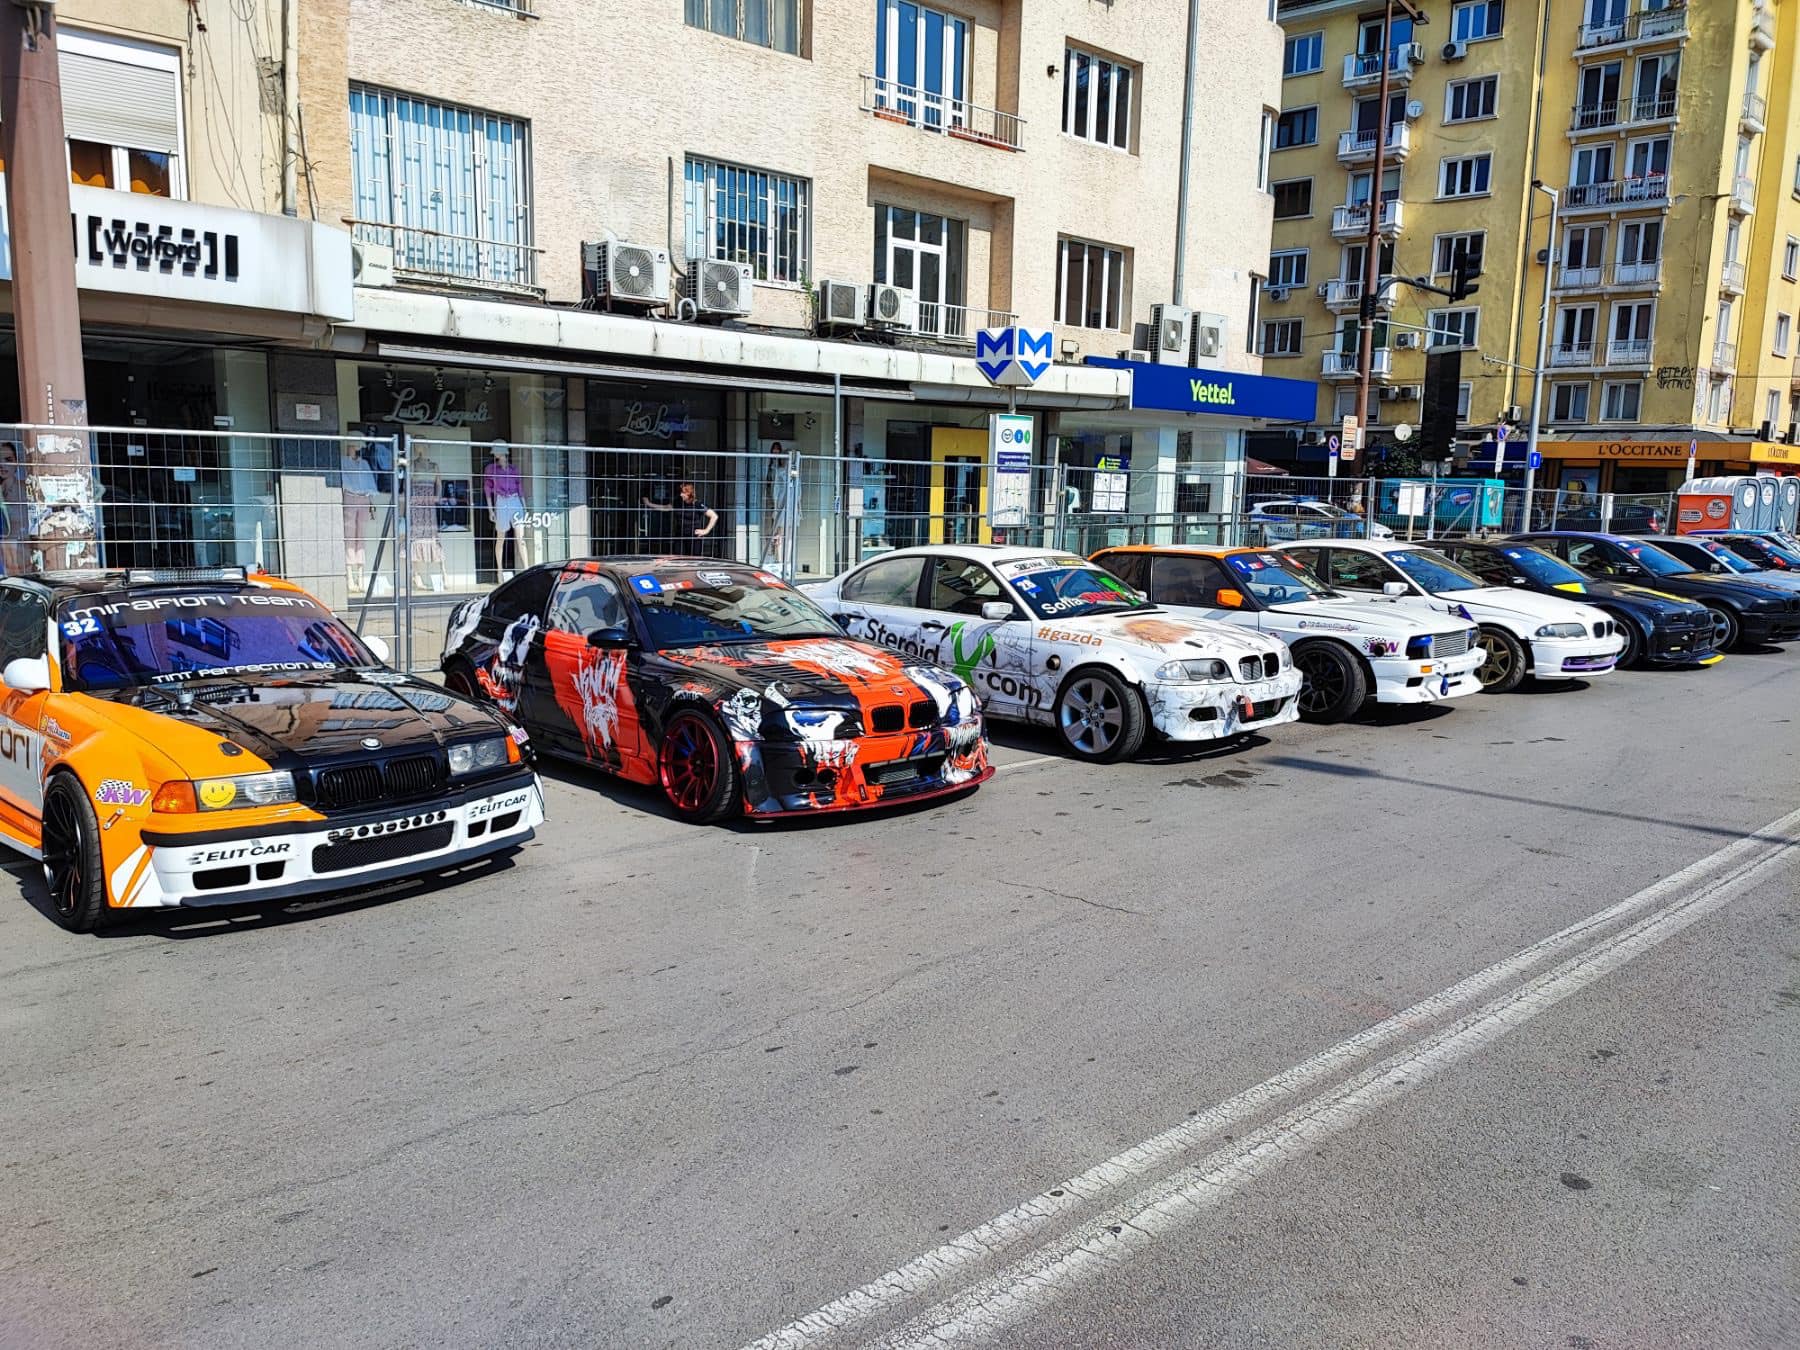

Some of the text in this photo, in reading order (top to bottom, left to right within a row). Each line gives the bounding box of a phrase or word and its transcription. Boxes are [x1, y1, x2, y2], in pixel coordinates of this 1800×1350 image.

[103, 229, 201, 261] Wolford
[1598, 443, 1682, 456] L'OCCITANE
[639, 579, 654, 590] 8
[1041, 597, 1083, 614] Sofia
[63, 618, 100, 636] 32
[1038, 626, 1103, 647] #gazda
[311, 661, 337, 671] BG
[102, 786, 150, 805] KW
[249, 843, 291, 857] CAR
